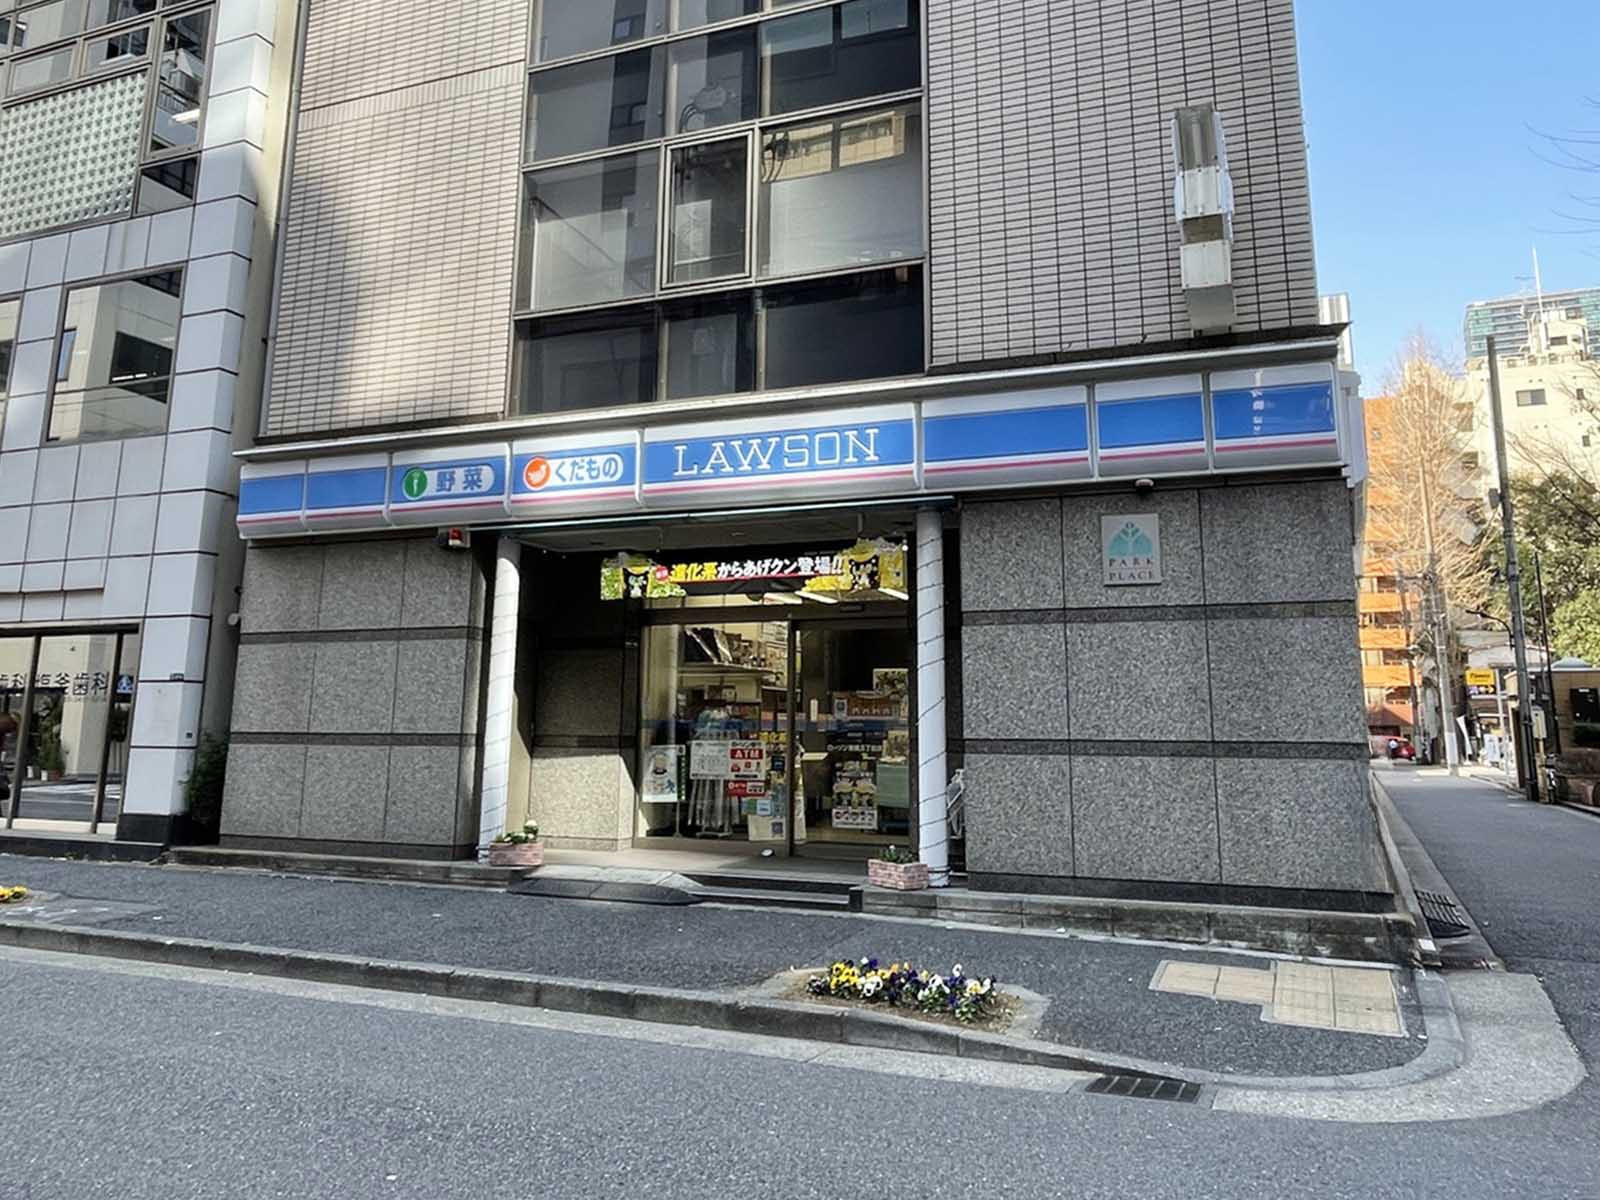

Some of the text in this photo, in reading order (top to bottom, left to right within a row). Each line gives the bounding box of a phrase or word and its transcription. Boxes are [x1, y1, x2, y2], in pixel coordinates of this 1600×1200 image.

[673, 428, 880, 476] LAWSON
[554, 457, 619, 483] くだもの
[436, 468, 484, 493] 野菜
[1109, 558, 1153, 568] PARK
[1109, 571, 1153, 581] PLACE
[735, 749, 760, 759] ATM
